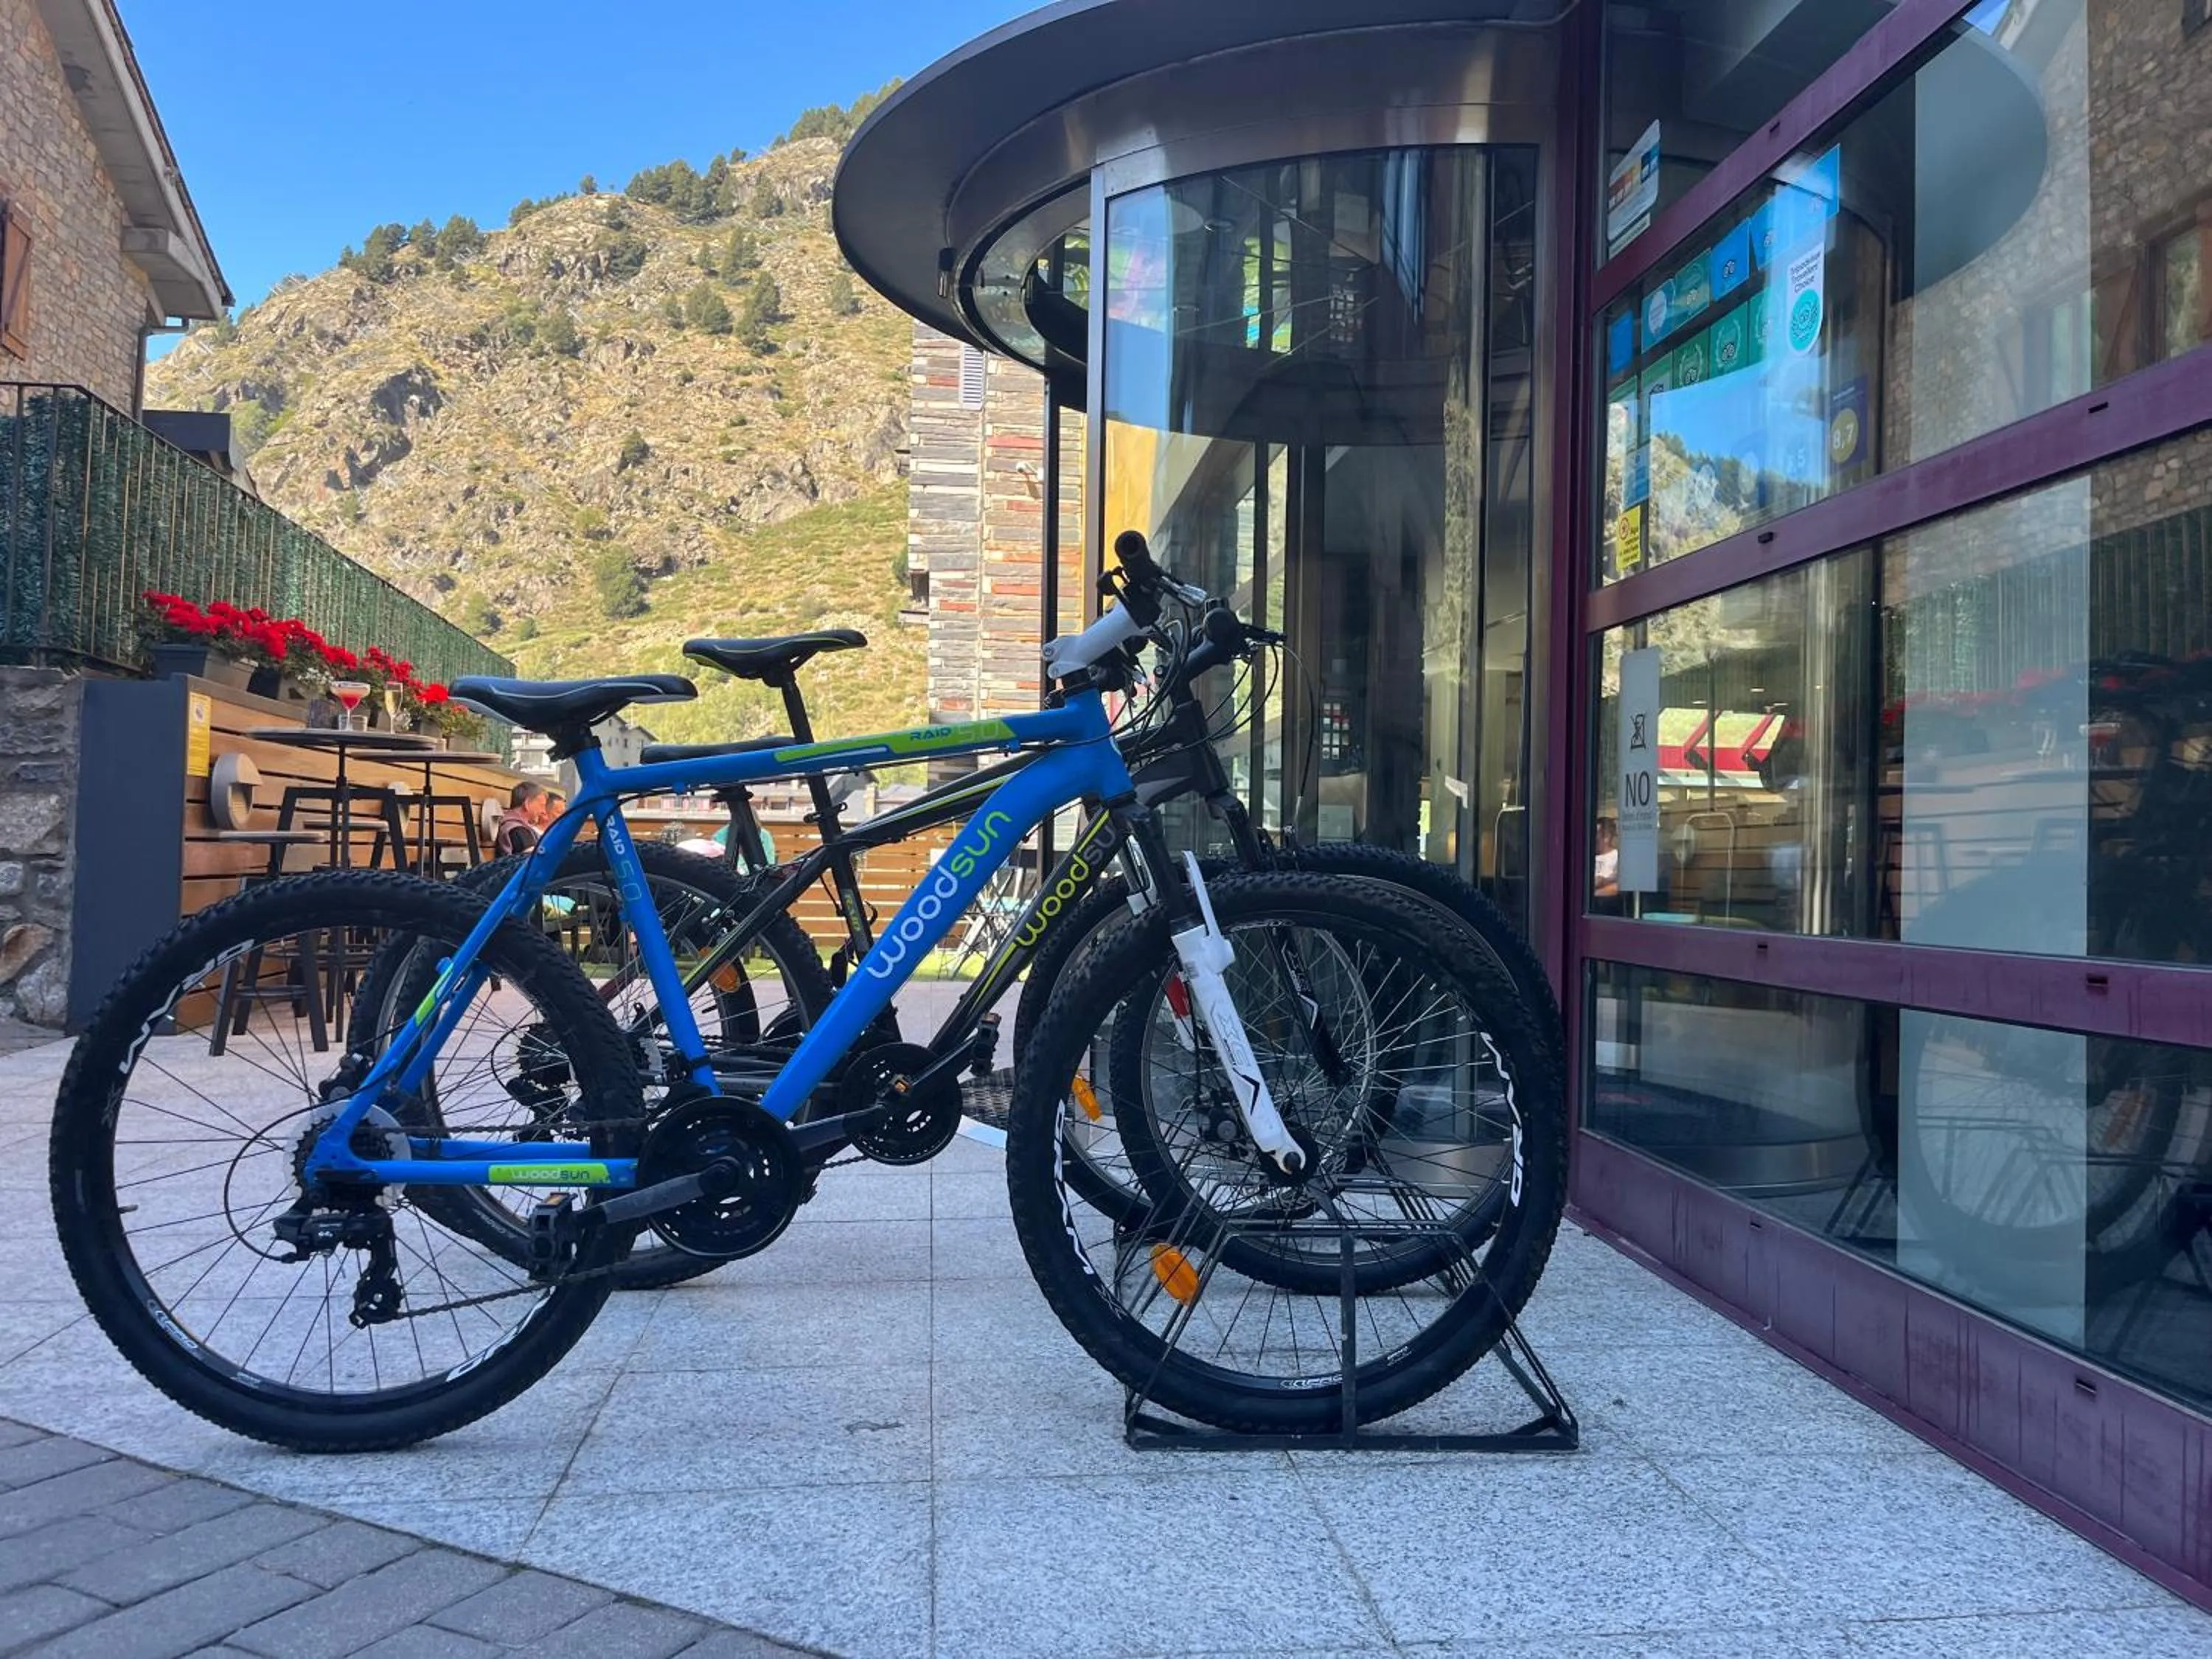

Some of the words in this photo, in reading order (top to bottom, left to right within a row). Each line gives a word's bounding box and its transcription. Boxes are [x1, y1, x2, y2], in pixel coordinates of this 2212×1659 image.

[1833, 423, 1854, 449] 8,7
[909, 726, 952, 741] RAID
[1626, 771, 1651, 807] NO
[606, 814, 626, 855] RAID
[866, 809, 1012, 979] woodsun
[1015, 824, 1117, 946] woodsu
[509, 1167, 590, 1180] woodsun
